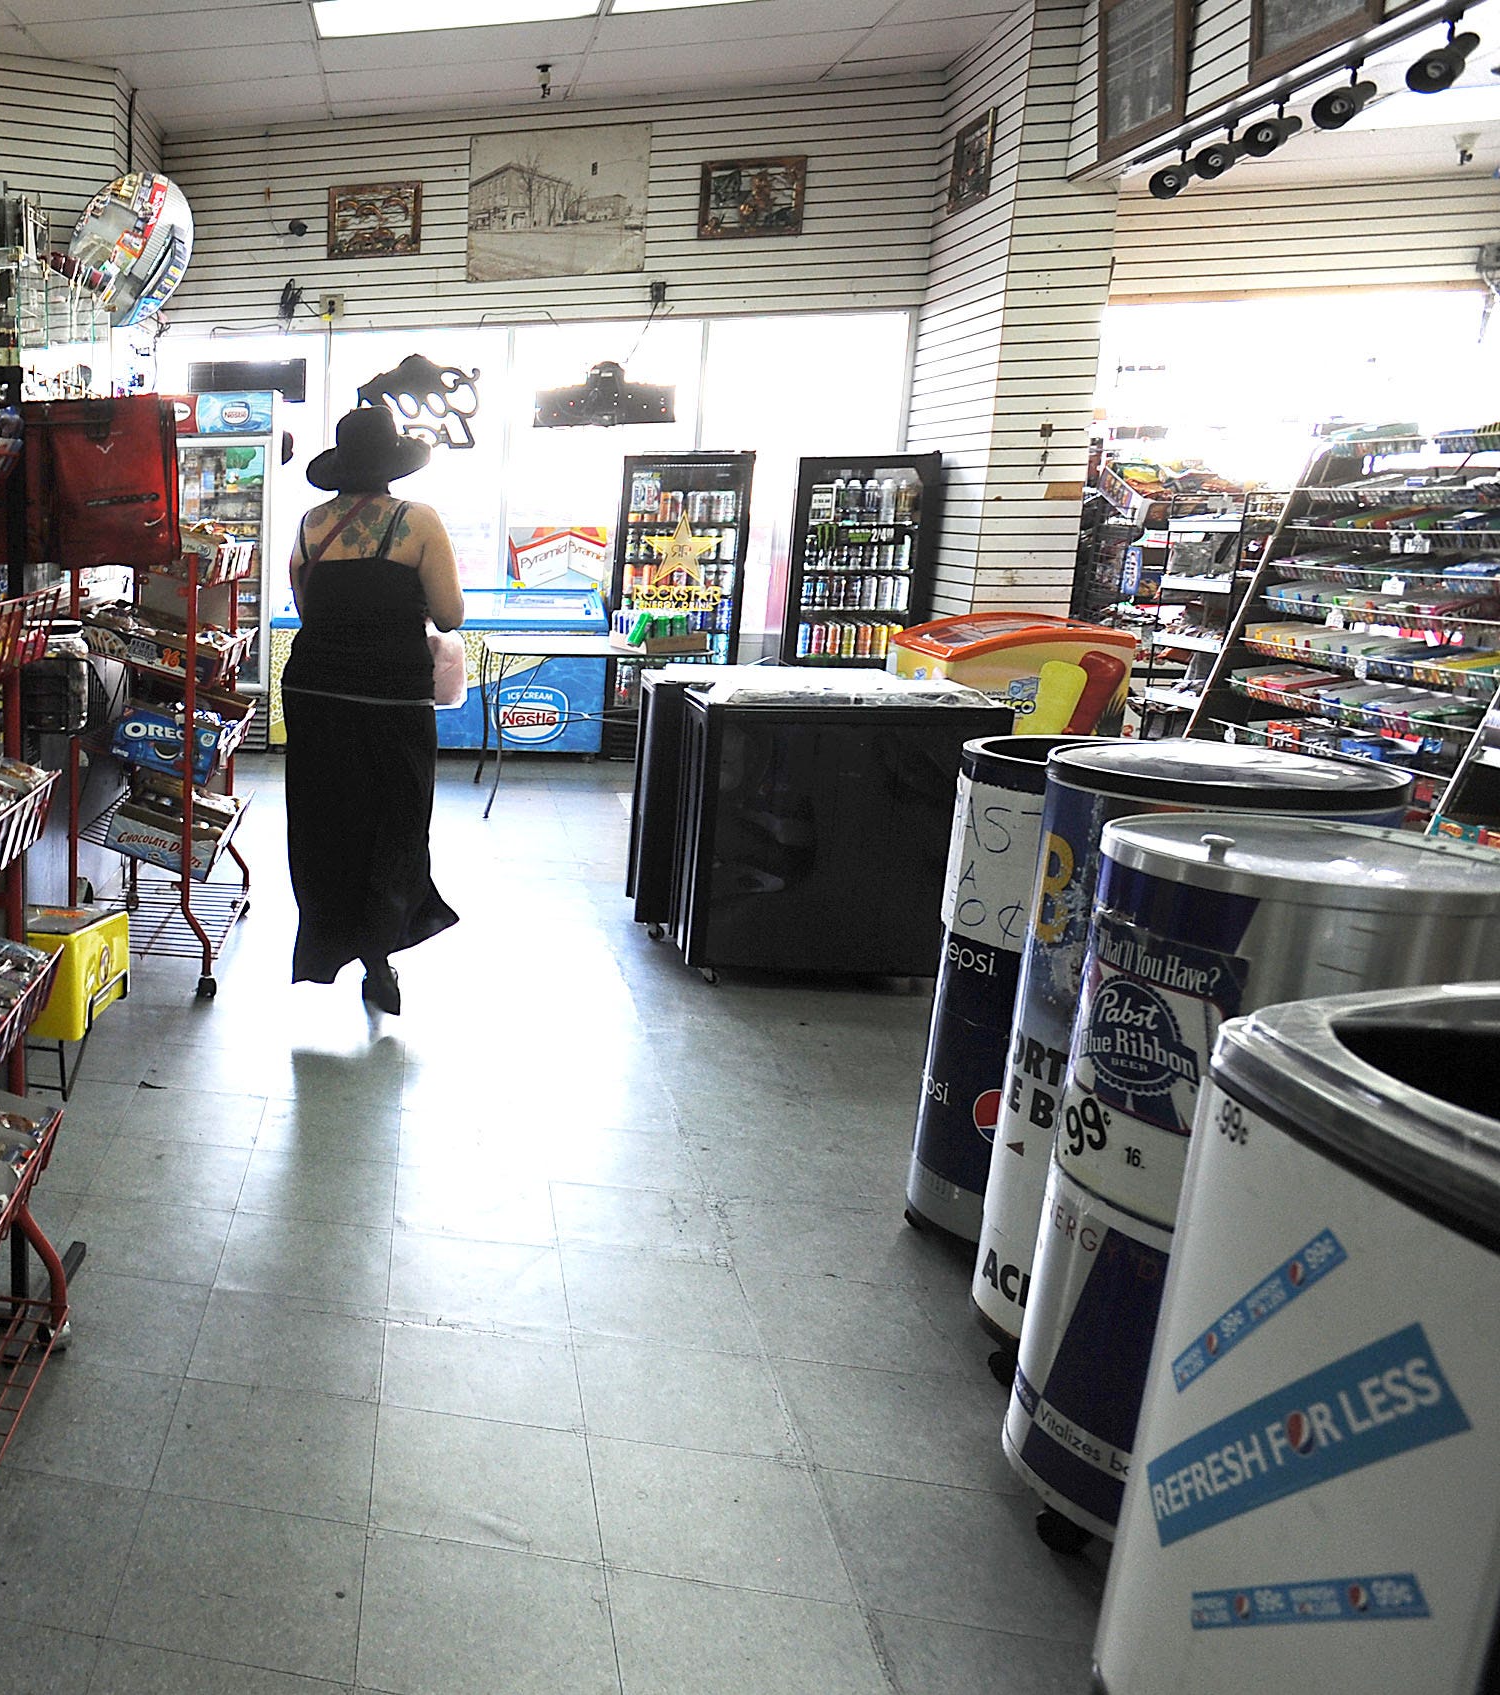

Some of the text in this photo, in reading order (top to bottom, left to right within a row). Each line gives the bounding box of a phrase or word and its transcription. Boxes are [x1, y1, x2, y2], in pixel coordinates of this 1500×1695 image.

[520, 541, 568, 569] Pyramid
[631, 585, 722, 604] ROCKSTAR
[507, 691, 553, 701] ICE CREAM
[117, 832, 168, 850] CHOCOLATE
[947, 940, 998, 978] epsi
[1134, 944, 1162, 981] You
[1097, 988, 1161, 1031] Pabst
[1080, 1027, 1197, 1080] Blue Ribbon
[1110, 1056, 1150, 1073] BEER
[1039, 1403, 1100, 1462] Vitalizes
[1151, 1357, 1440, 1521] REFRESH FOR LESS
